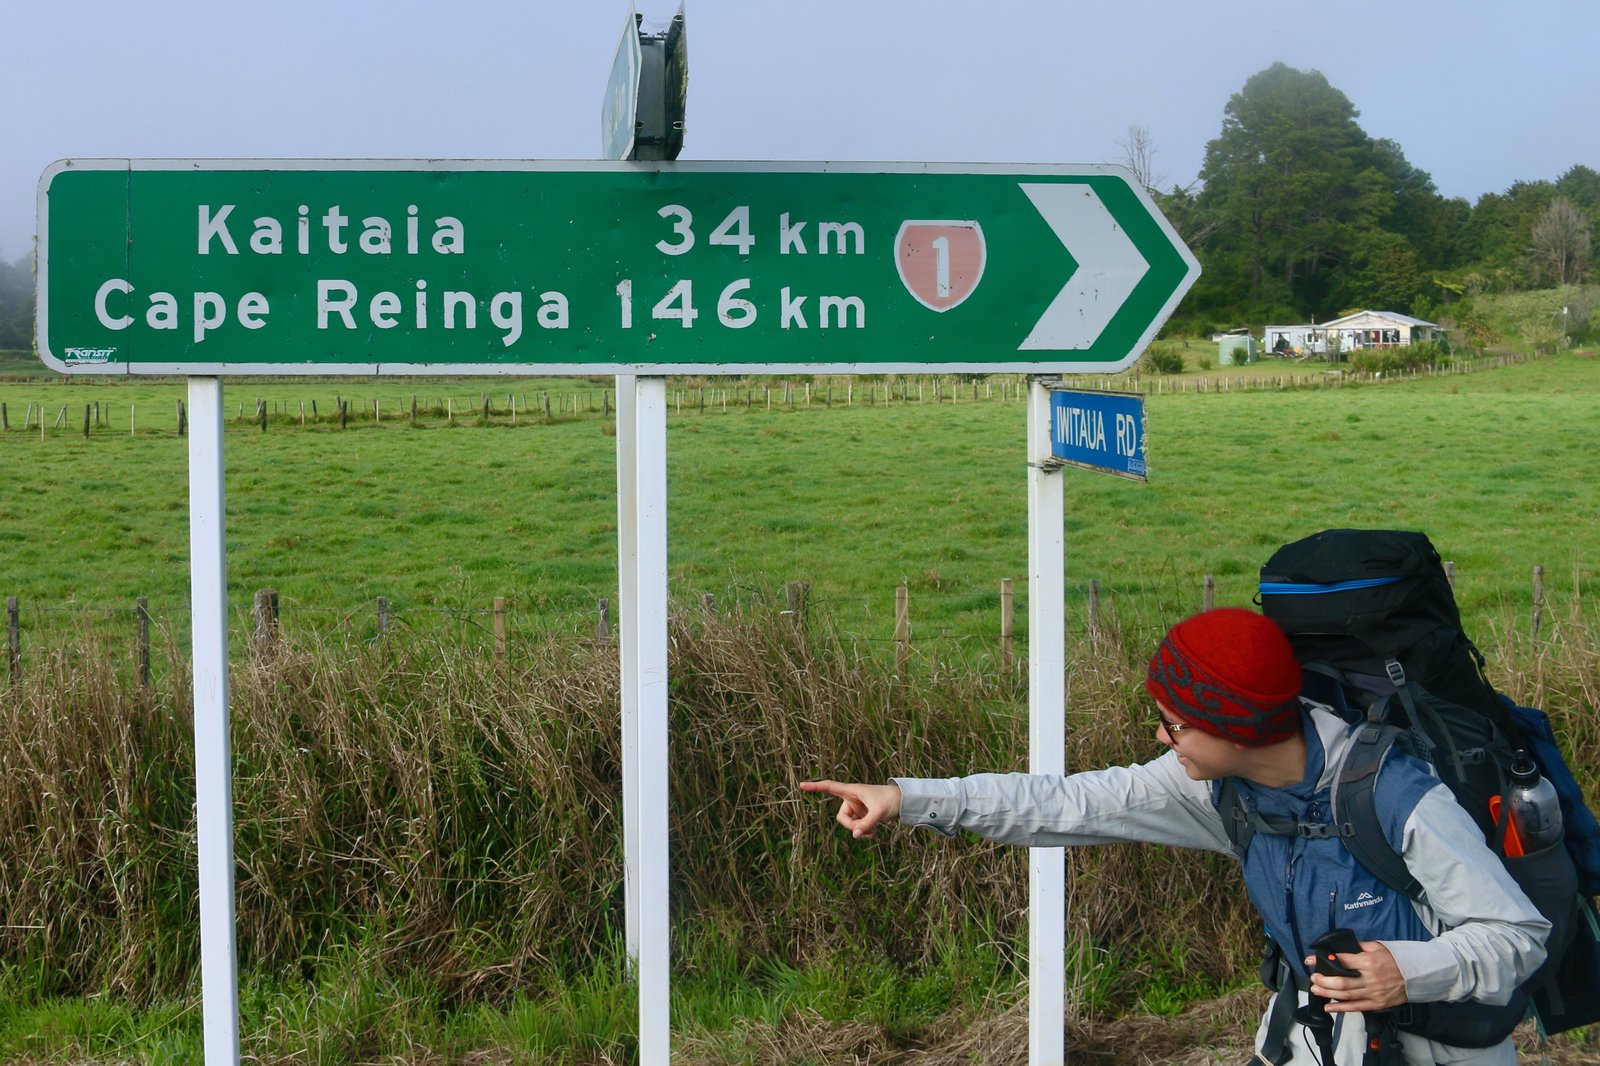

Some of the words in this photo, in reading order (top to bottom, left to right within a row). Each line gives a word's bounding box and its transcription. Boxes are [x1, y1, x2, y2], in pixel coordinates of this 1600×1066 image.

[198, 204, 464, 255] Kaitaia
[655, 204, 755, 256] 34
[780, 211, 866, 256] km
[932, 235, 950, 298] 1
[94, 278, 271, 344] Cape
[316, 278, 570, 347] Reinga
[615, 278, 759, 330] 146
[780, 286, 866, 330] km
[1056, 405, 1107, 452] IWITAUA
[1116, 413, 1137, 457] RD
[1343, 896, 1383, 910] Kathmandu
